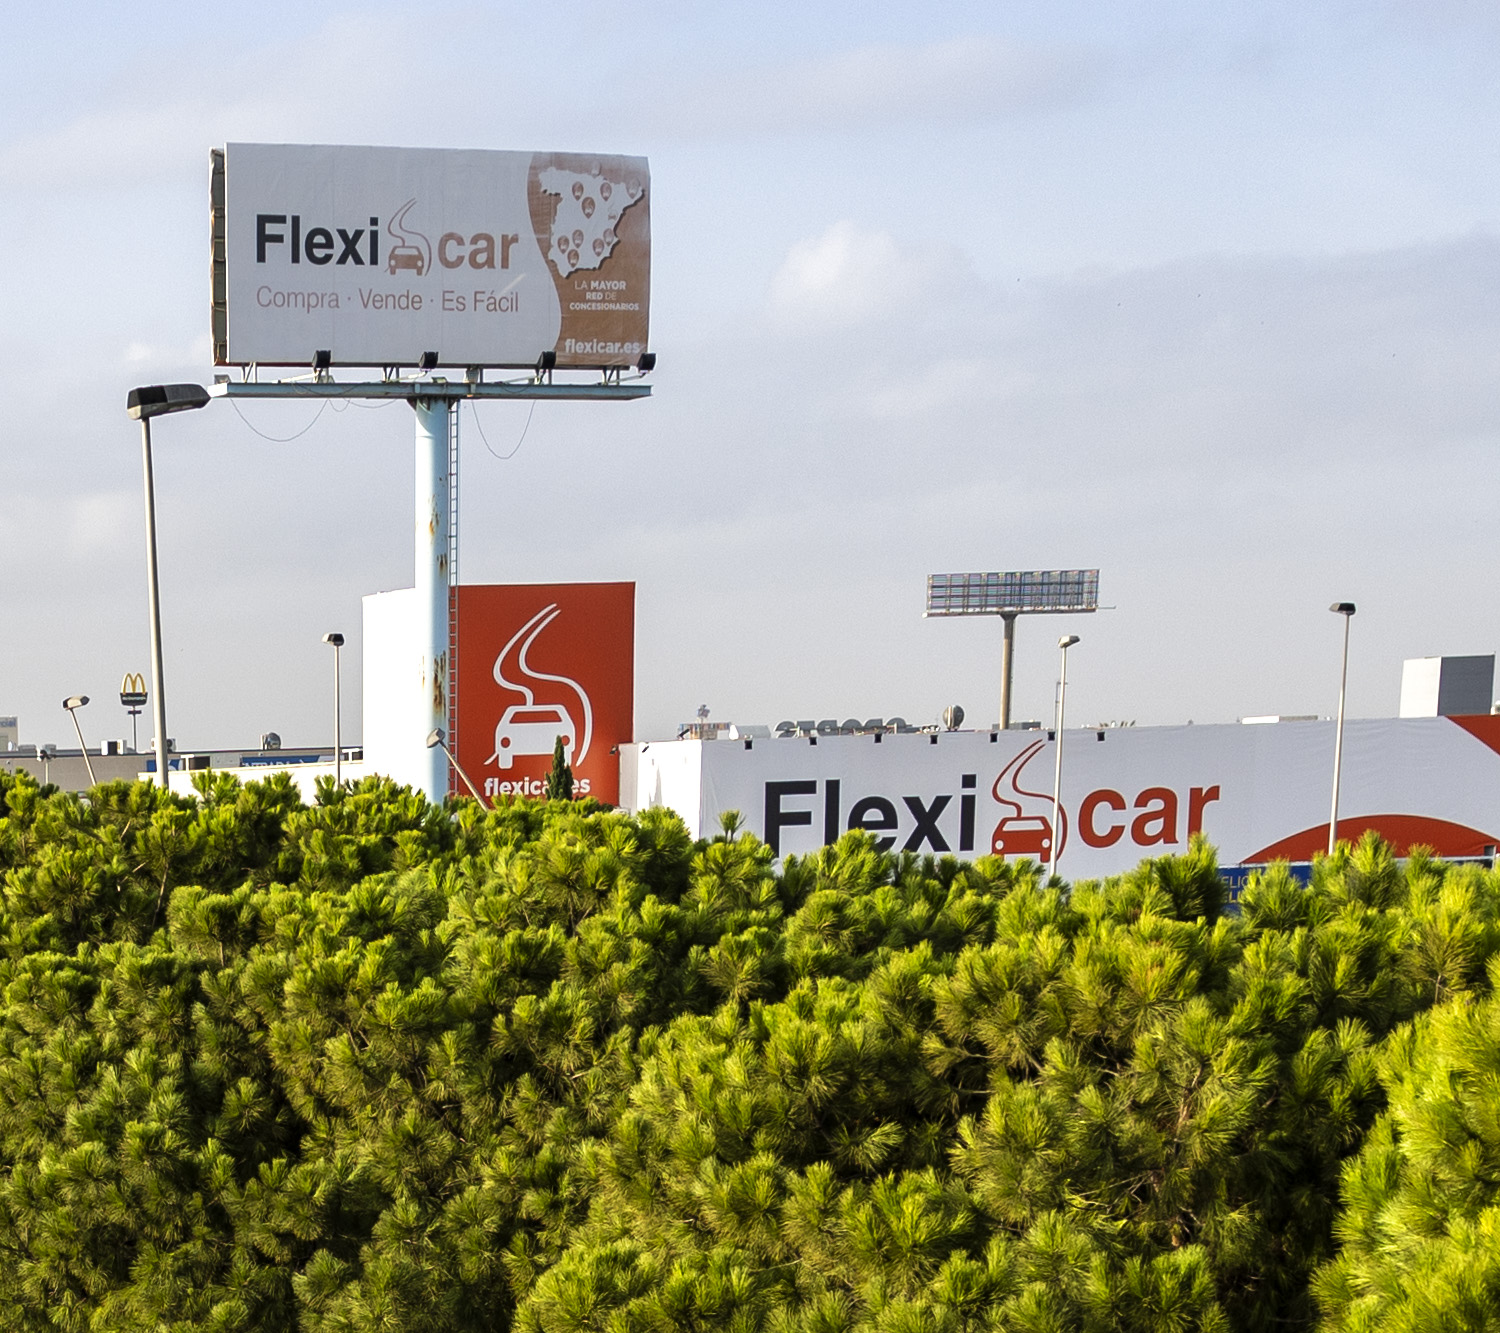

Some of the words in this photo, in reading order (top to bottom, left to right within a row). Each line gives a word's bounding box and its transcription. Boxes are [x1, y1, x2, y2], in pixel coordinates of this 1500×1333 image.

[256, 214, 379, 266] Flexi
[438, 230, 519, 270] car
[574, 280, 588, 290] LA
[590, 281, 627, 290] MAYOR
[256, 285, 340, 313] Compra
[358, 288, 423, 311] Vende
[441, 290, 466, 312] Es
[474, 289, 519, 312] Fácil
[586, 292, 603, 300] RED
[605, 292, 617, 300] DE
[569, 302, 640, 311] CONCESIONARIOS
[565, 339, 640, 354] flexicar.es
